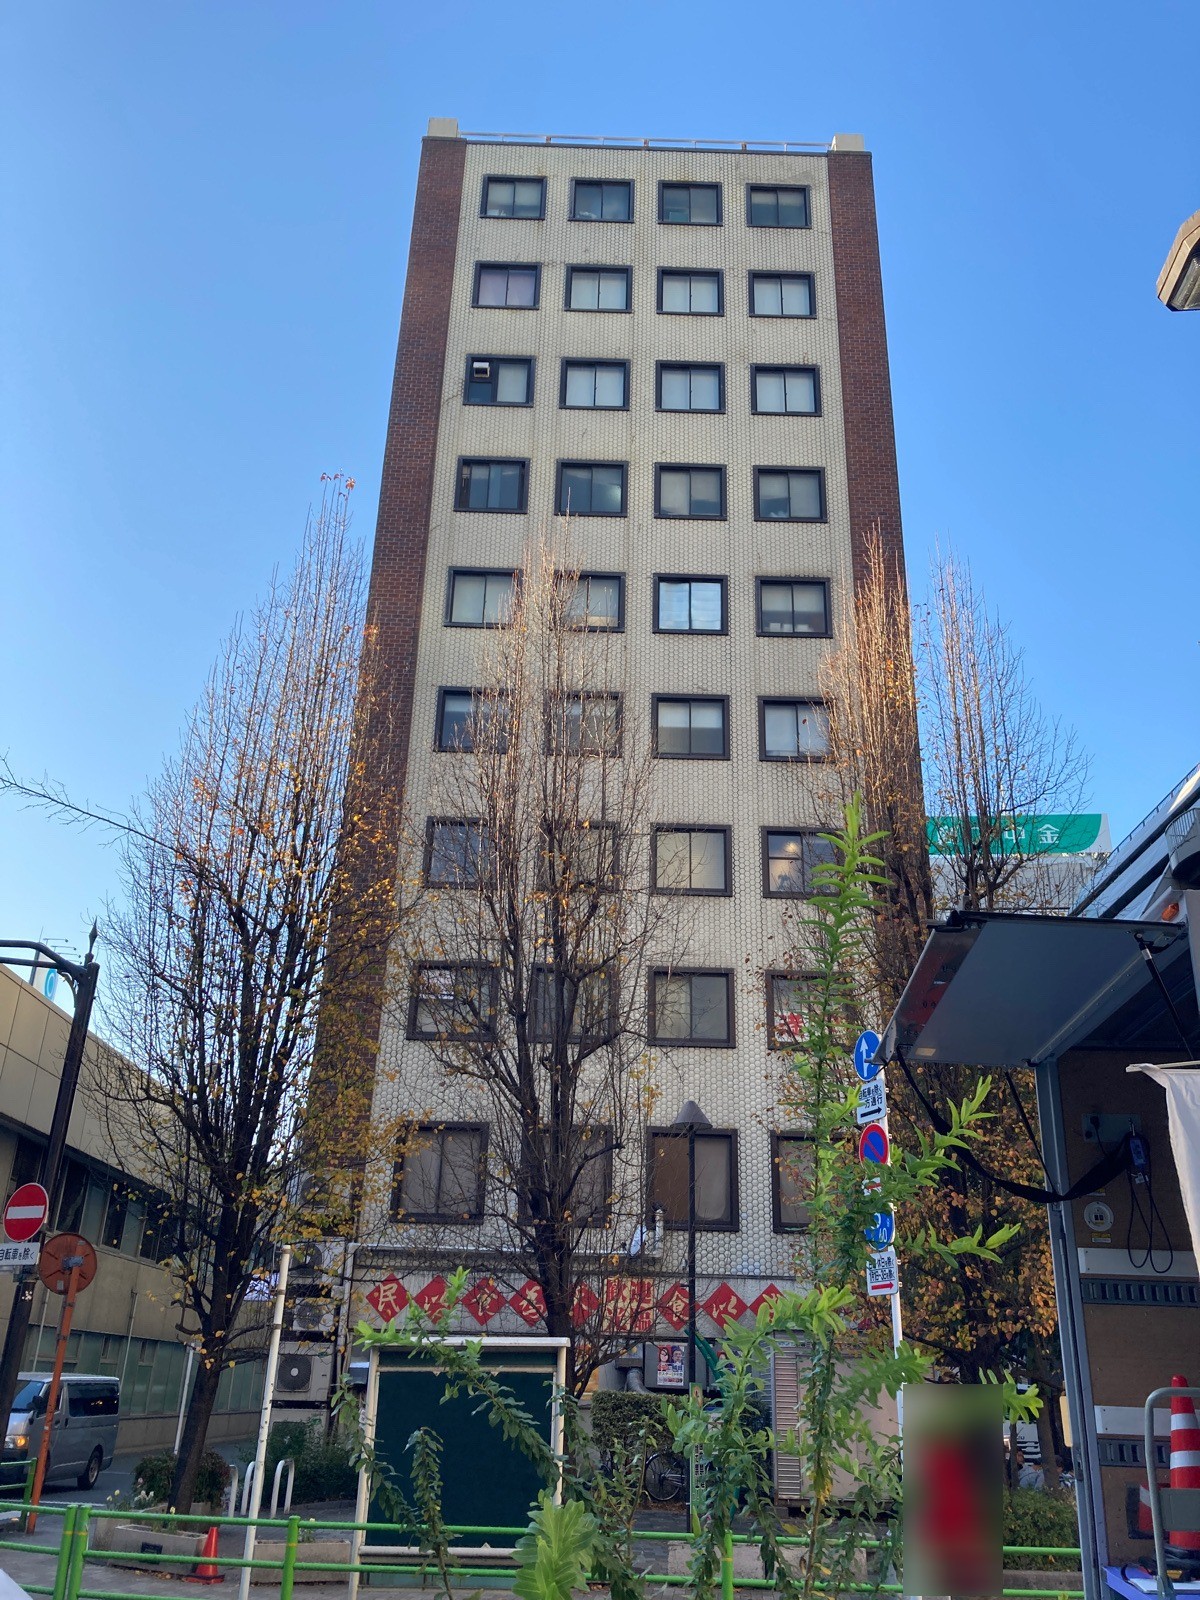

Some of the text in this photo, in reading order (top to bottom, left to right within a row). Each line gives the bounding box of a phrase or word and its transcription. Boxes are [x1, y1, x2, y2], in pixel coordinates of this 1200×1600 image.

[862, 1095, 883, 1109] 方通行
[0, 1247, 35, 1261] 自転車を除く
